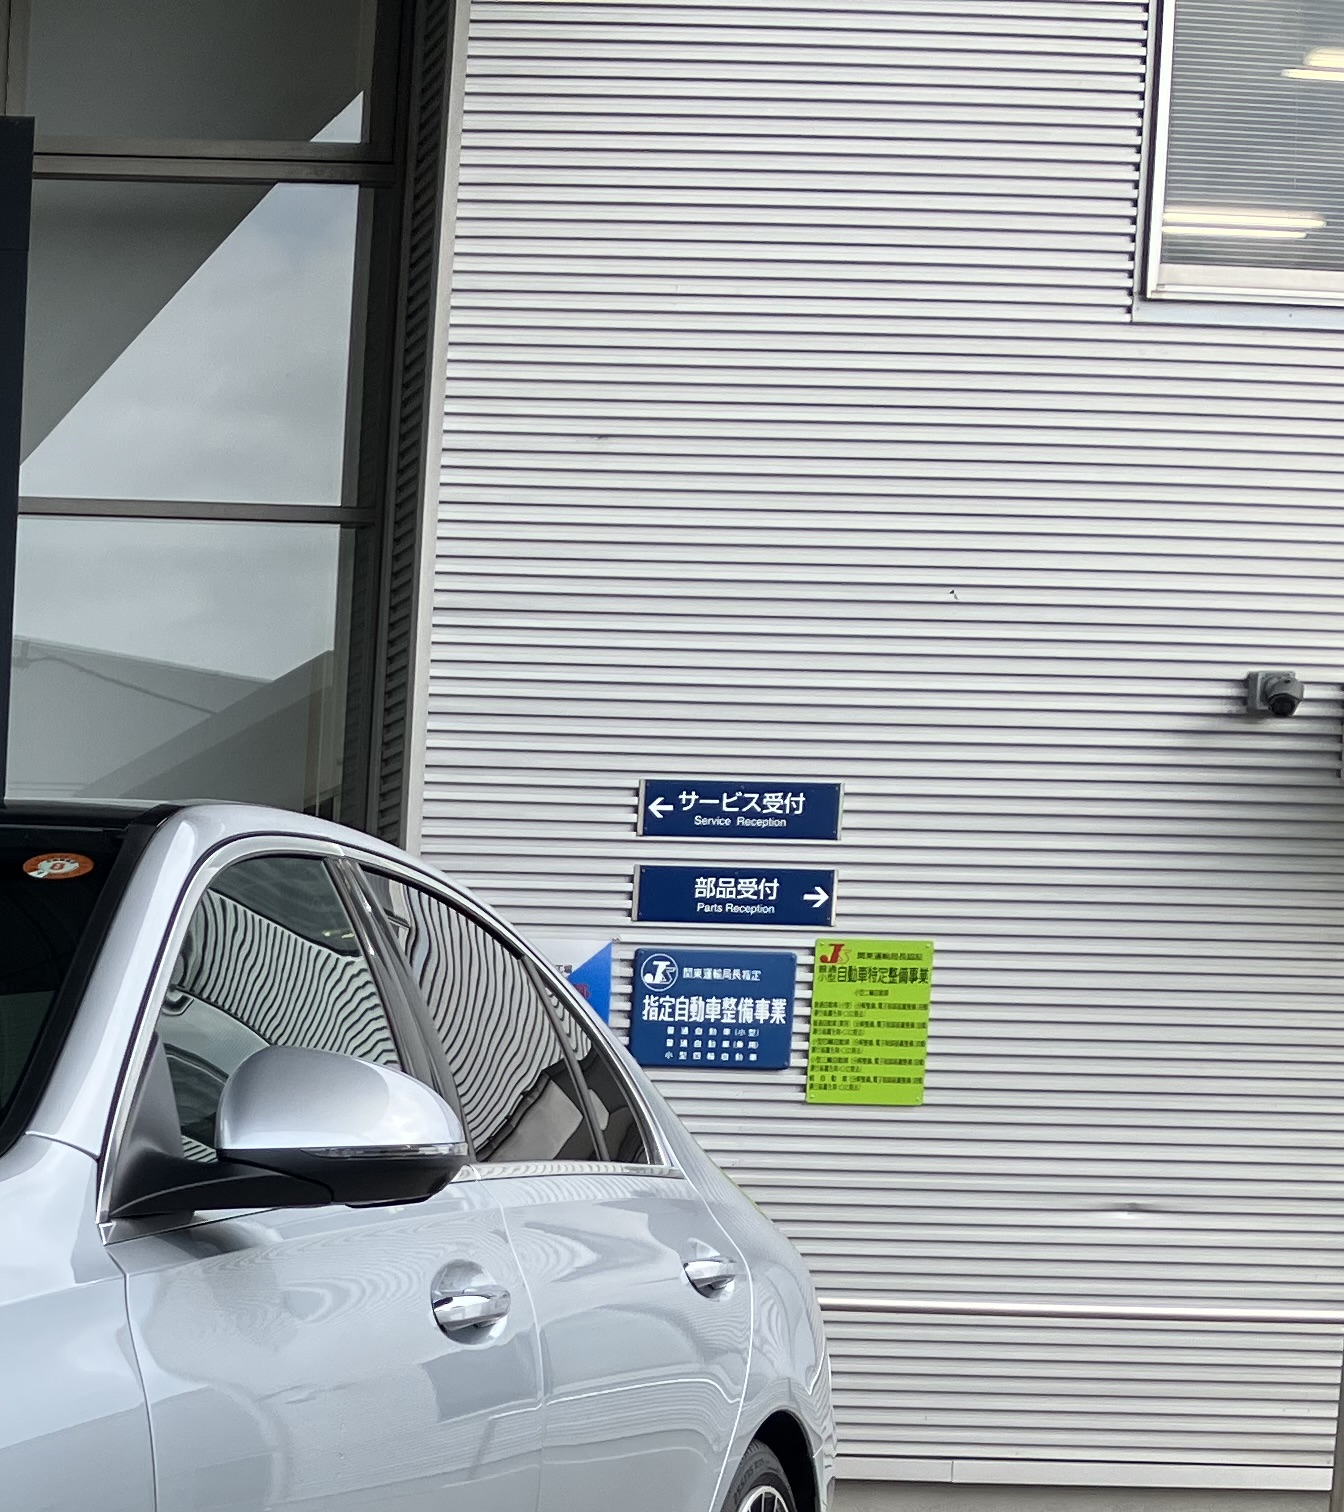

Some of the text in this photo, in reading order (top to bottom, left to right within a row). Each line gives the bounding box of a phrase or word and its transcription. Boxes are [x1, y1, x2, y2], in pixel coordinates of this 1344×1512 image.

[678, 790, 807, 815] サービス受付
[693, 815, 787, 829] Service Reception
[694, 877, 780, 900] 部品受付
[697, 902, 776, 917] Parts Reception
[642, 994, 787, 1024] 指定自動車整備事業
